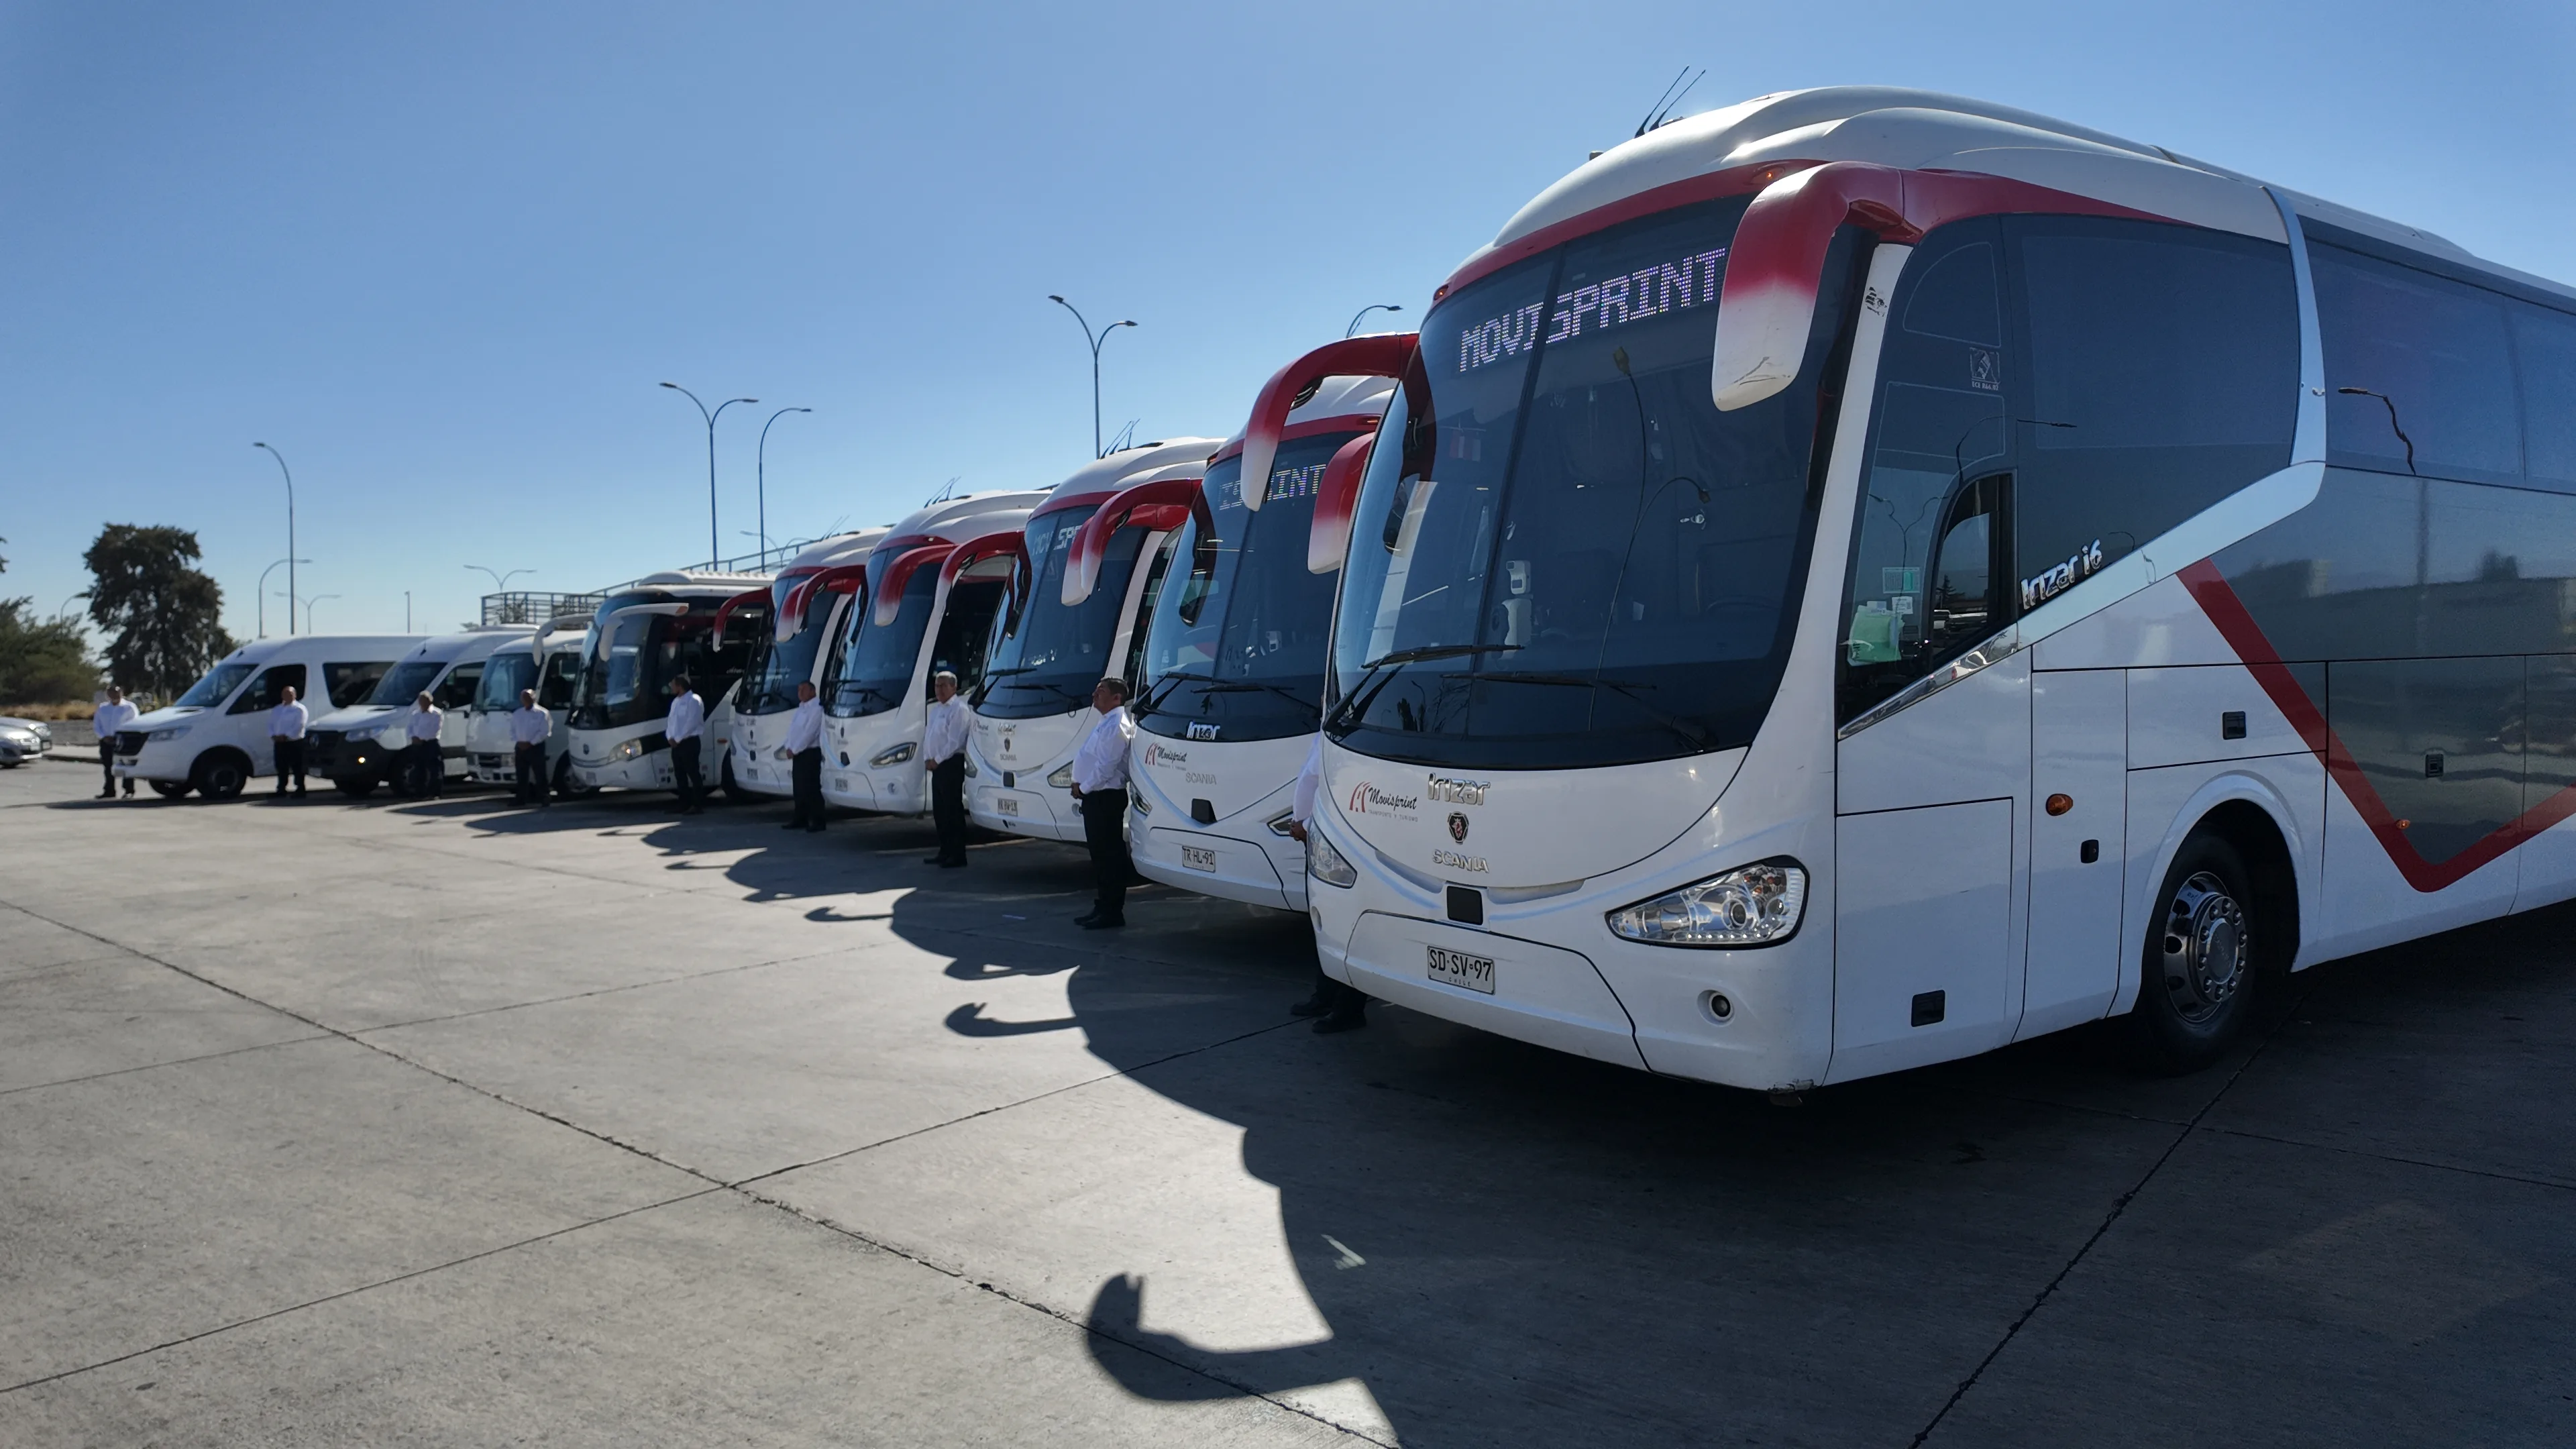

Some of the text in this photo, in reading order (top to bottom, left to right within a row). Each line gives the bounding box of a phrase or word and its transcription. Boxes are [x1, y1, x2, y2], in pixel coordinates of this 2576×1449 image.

[2082, 539, 2102, 576] i6
[1185, 772, 1217, 785] SCANIA
[1368, 787, 1417, 810] Movisprint
[1433, 849, 1489, 873] SCANIA
